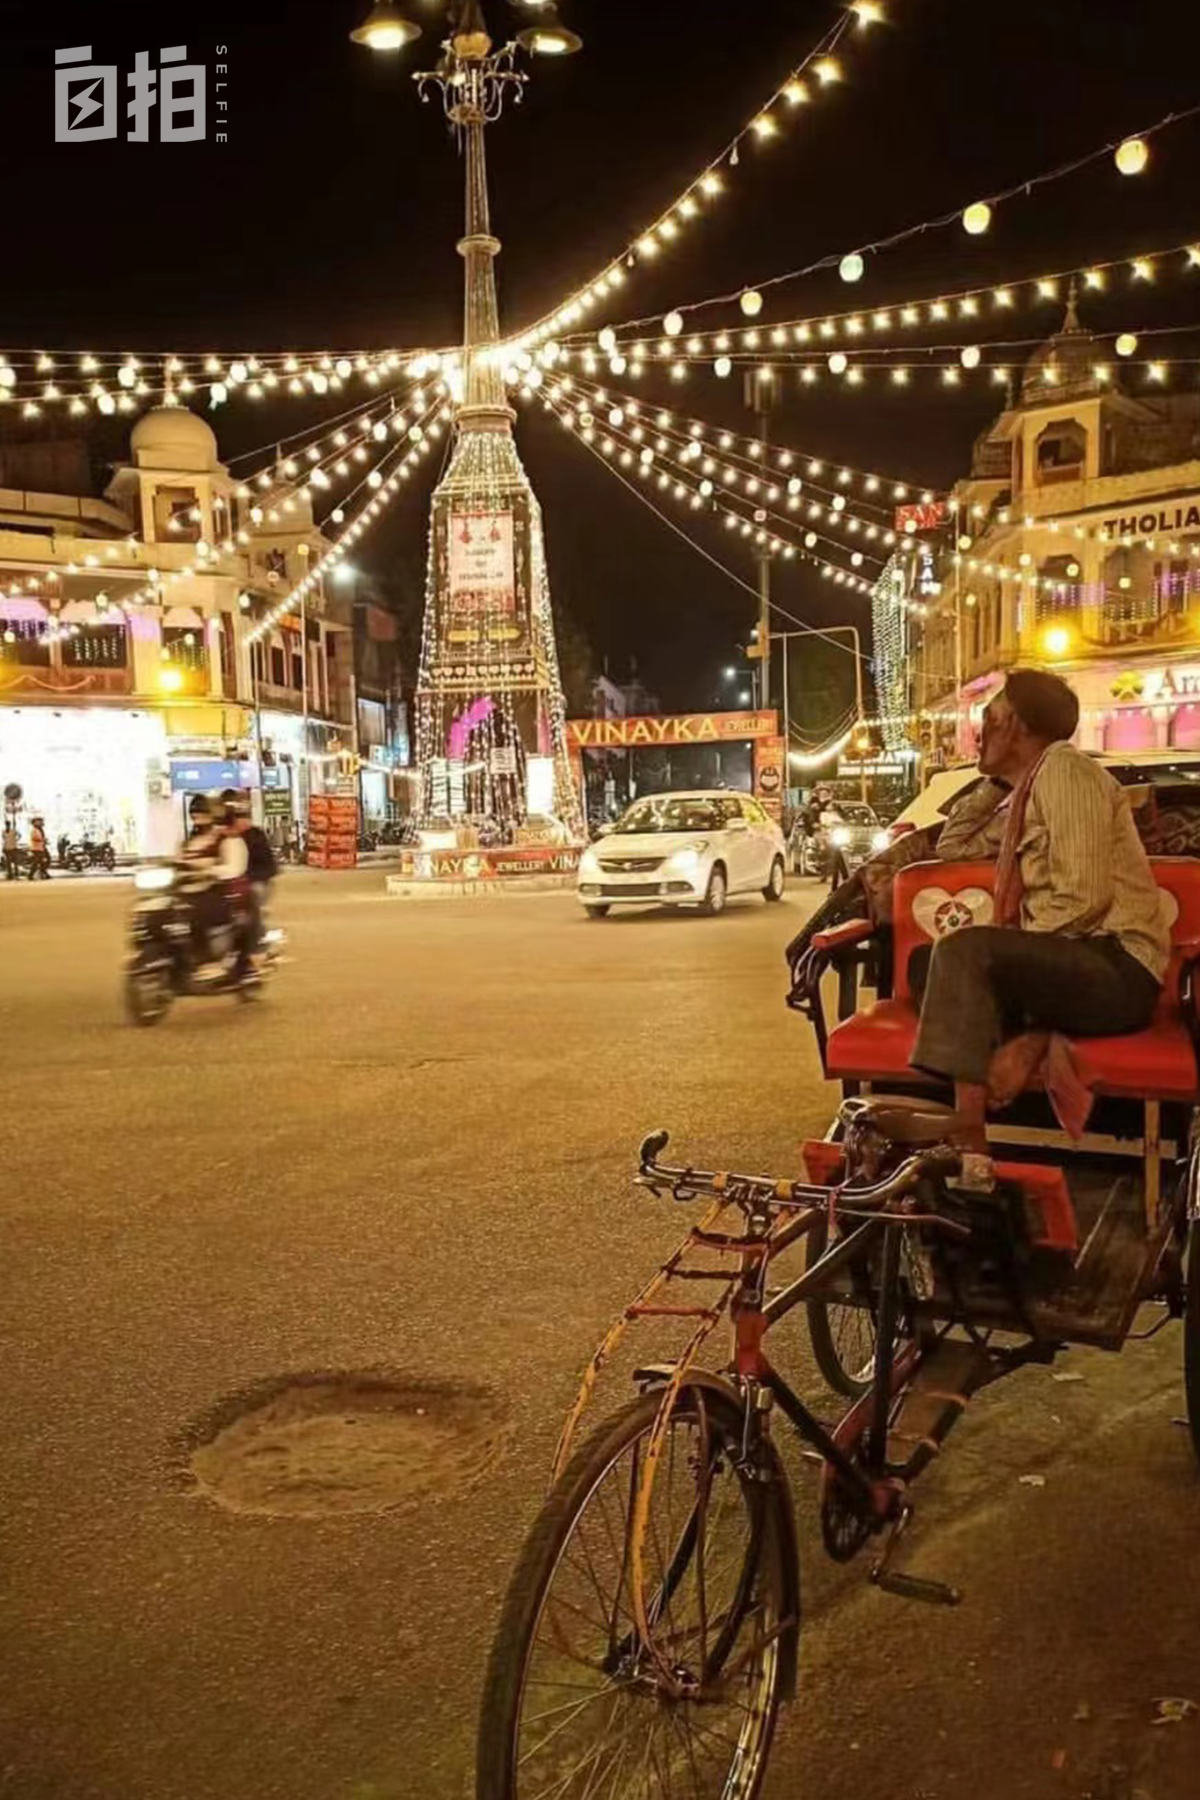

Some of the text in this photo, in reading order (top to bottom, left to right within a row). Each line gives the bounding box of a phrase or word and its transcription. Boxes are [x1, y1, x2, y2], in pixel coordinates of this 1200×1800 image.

[1102, 505, 1200, 540] THOLIA
[572, 717, 720, 744] VINAYKA
[496, 860, 544, 873] JEWELLERY
